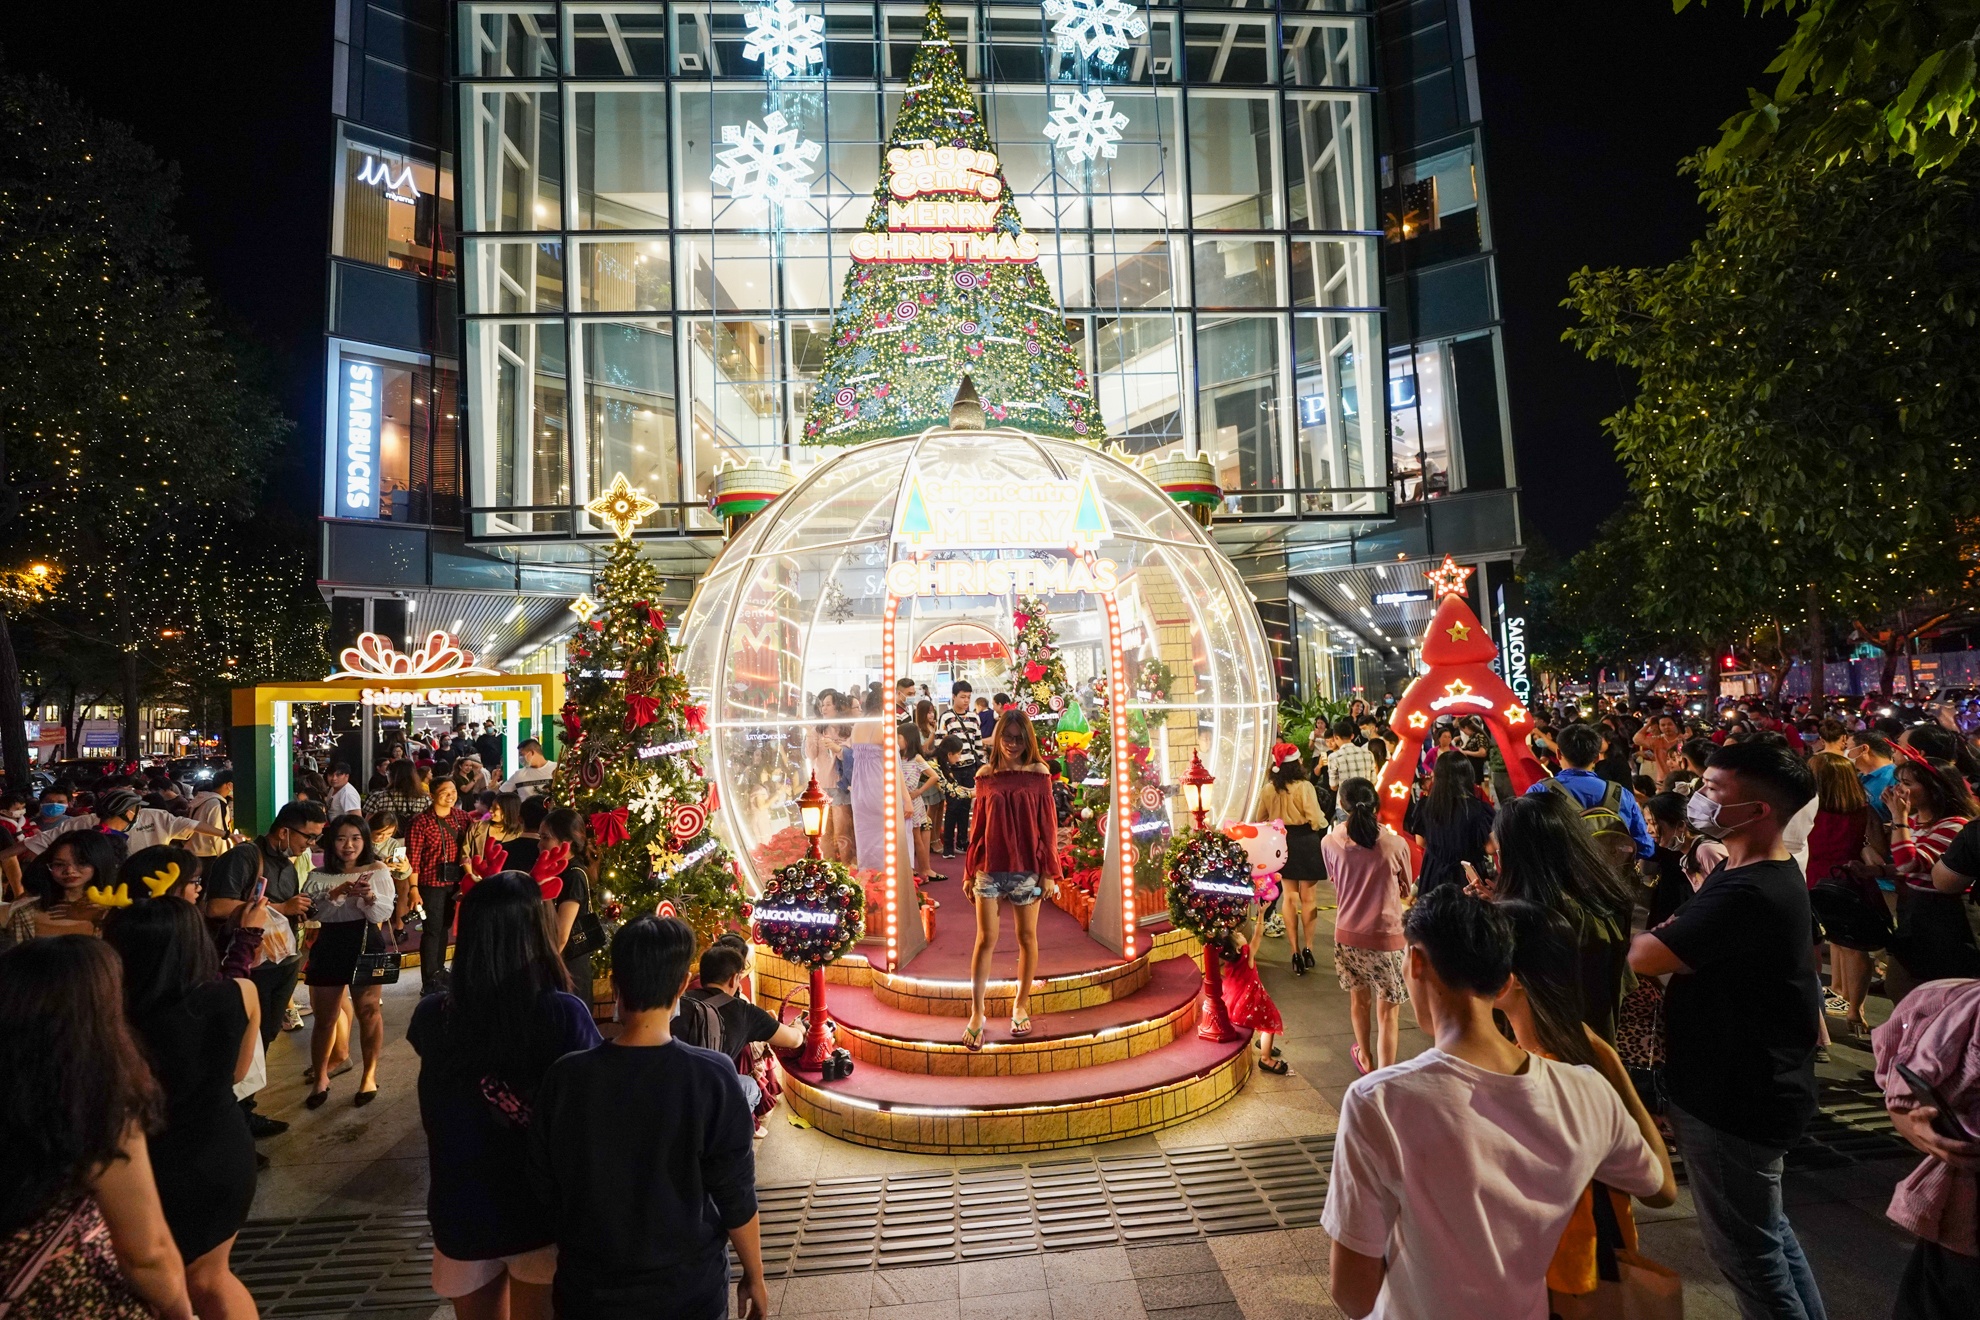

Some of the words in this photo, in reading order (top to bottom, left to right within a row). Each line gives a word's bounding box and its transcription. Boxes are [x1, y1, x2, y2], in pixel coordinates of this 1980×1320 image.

[887, 142, 998, 175] Saigon
[890, 169, 1001, 198] Centre
[889, 202, 999, 227] MERRY
[851, 233, 1039, 260] CHRISTMAS
[346, 364, 373, 509] STARBUCKS
[934, 509, 1070, 543] MERRY
[886, 558, 1118, 597] CHRISTMAS
[361, 687, 424, 708] Saigon
[428, 688, 484, 706] Centre
